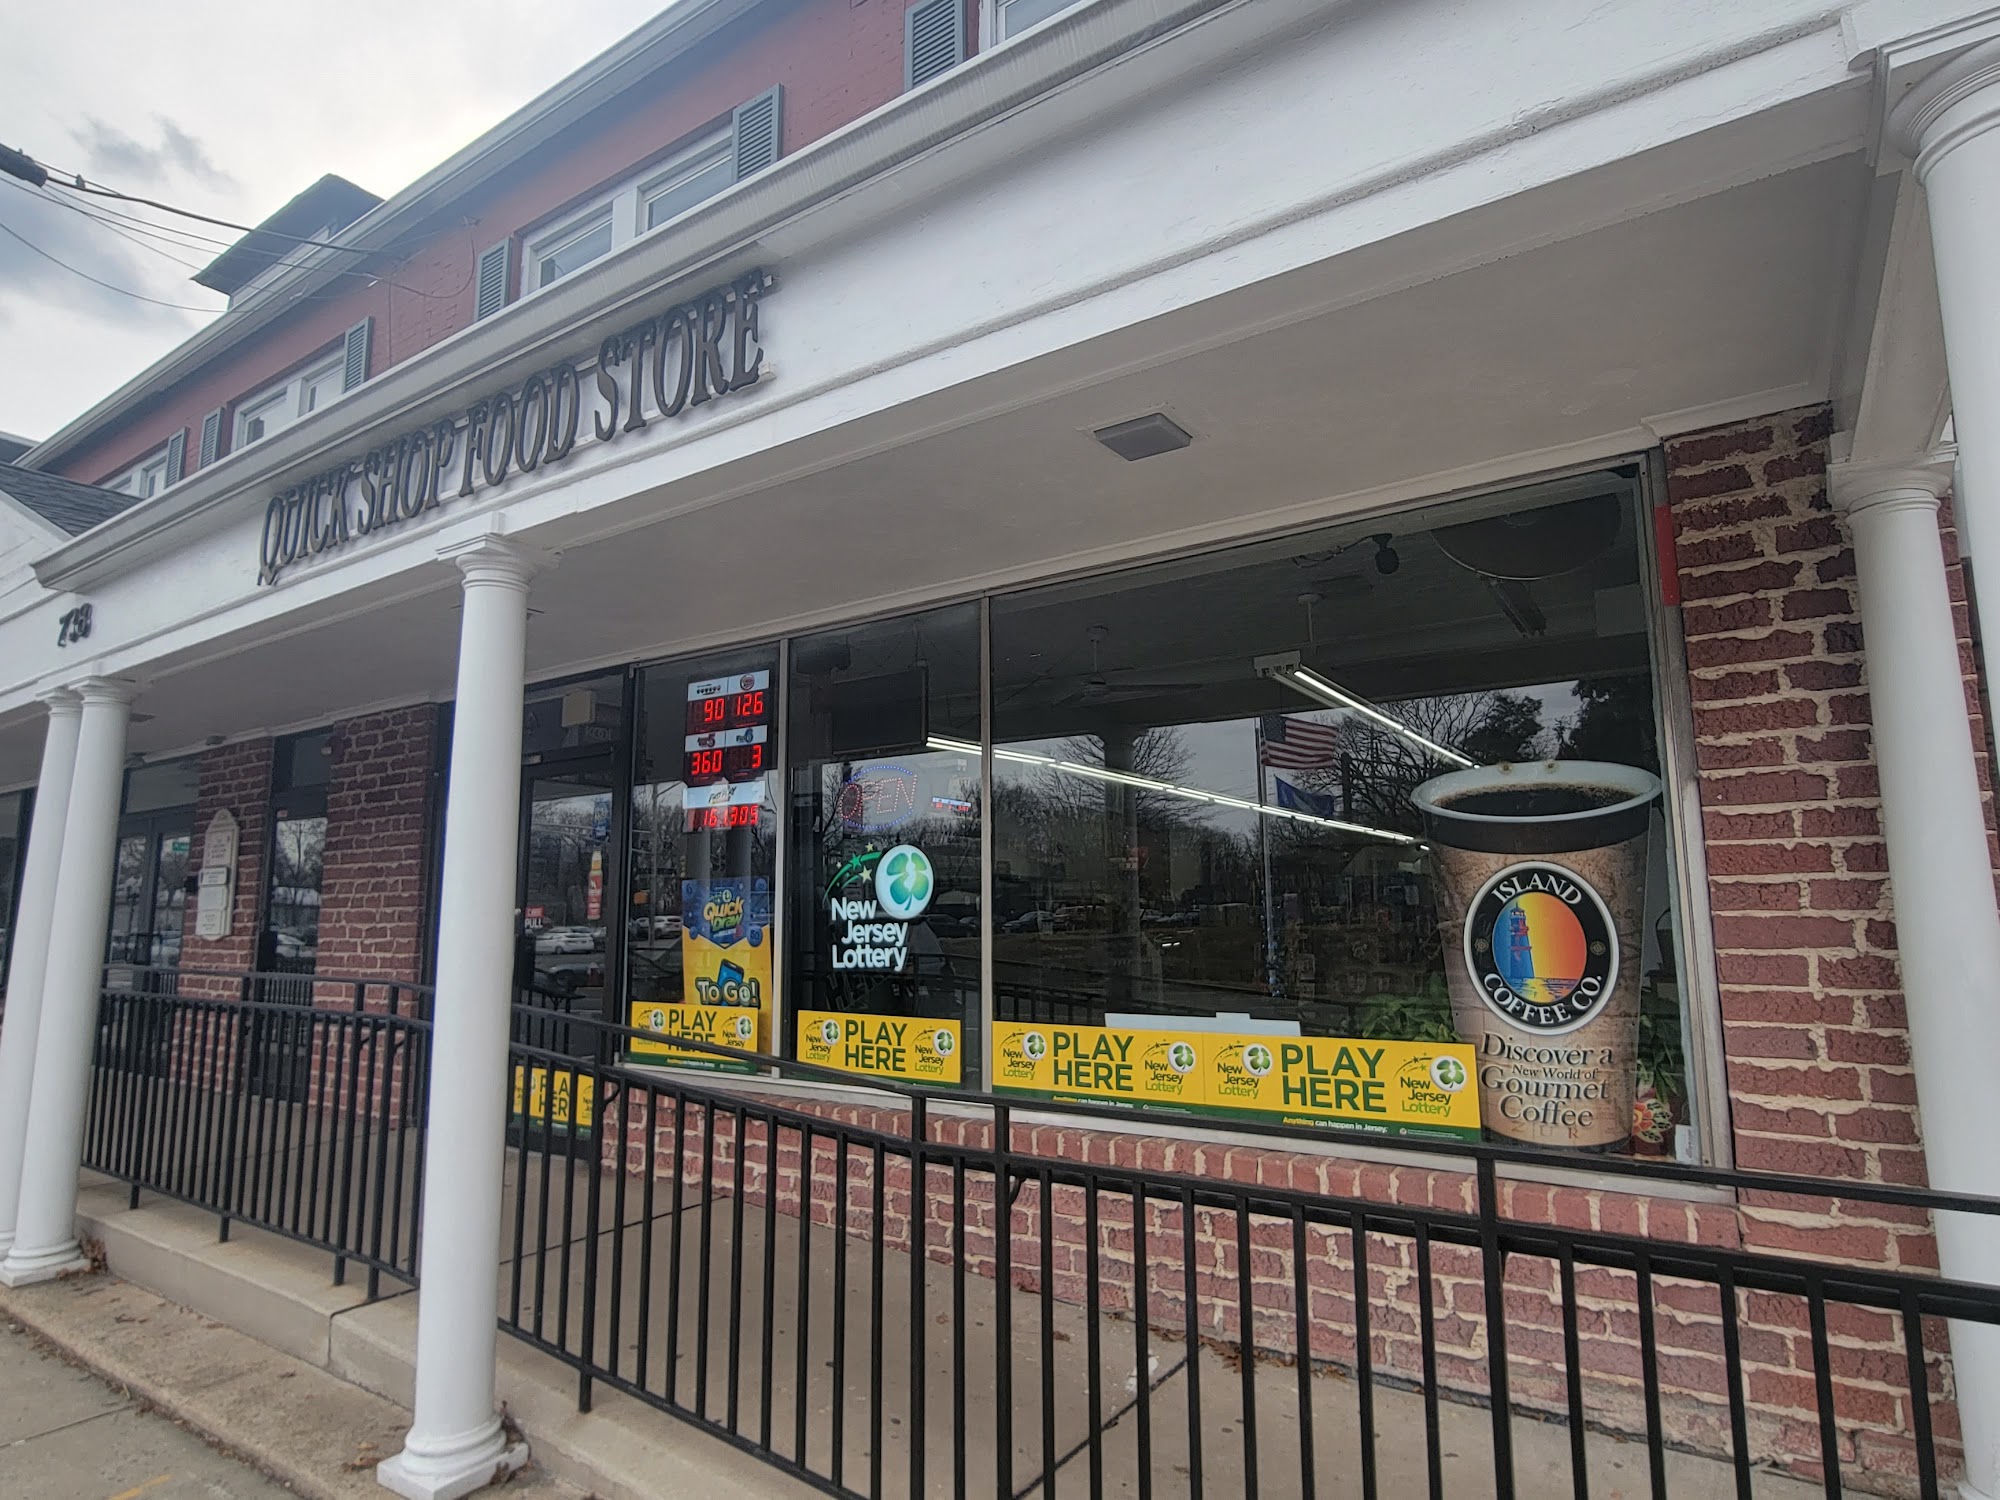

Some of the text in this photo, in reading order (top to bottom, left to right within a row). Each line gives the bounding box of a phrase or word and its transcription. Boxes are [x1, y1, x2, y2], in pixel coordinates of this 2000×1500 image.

[257, 266, 764, 585] QUICK SHOP FOOD STORE
[705, 691, 763, 722] 90 126
[691, 744, 762, 775] 360 3
[840, 774, 918, 818] OPEN
[1491, 872, 1582, 905] ISLAND
[703, 896, 745, 931] Quick
[831, 897, 877, 920] New
[525, 917, 543, 929] PULL
[841, 920, 908, 946] Jersey
[832, 944, 907, 972] Lottery
[698, 981, 720, 1000] To
[1484, 973, 1602, 1024] COFFEE CO.
[668, 1009, 717, 1032] PLAY
[722, 1029, 736, 1039] New
[806, 1034, 821, 1043] New
[845, 1019, 908, 1047] PLAY
[809, 1042, 832, 1053] Jersey
[915, 1045, 933, 1055] New
[1002, 1048, 1023, 1059] New
[1053, 1031, 1134, 1062] PLAY
[1481, 1031, 1613, 1065] Discover a
[805, 1052, 832, 1063] Lottery
[845, 1044, 906, 1072] HERE
[918, 1054, 945, 1066] Jersey
[1007, 1058, 1036, 1071] Jersey
[1145, 1060, 1168, 1071] New
[1281, 1043, 1386, 1078] PLAY
[914, 1062, 944, 1075] Lottery
[1003, 1068, 1036, 1080] Lottery
[1053, 1060, 1134, 1091] HERE
[1217, 1063, 1243, 1074] New
[1511, 1064, 1599, 1080] New World of
[1150, 1071, 1183, 1085] Jersey
[1223, 1074, 1260, 1088] Jersey
[1400, 1076, 1431, 1089] New
[1481, 1065, 1611, 1100] Gourmet
[1145, 1082, 1183, 1096] Lottery
[1218, 1084, 1260, 1100] Lottery
[1282, 1075, 1387, 1113] HERE
[1407, 1089, 1452, 1105] Jersey
[1401, 1101, 1452, 1118] Lottery
[1500, 1095, 1594, 1127] Coffee
[1328, 1120, 1354, 1131] happen
[1355, 1122, 1363, 1130] in
